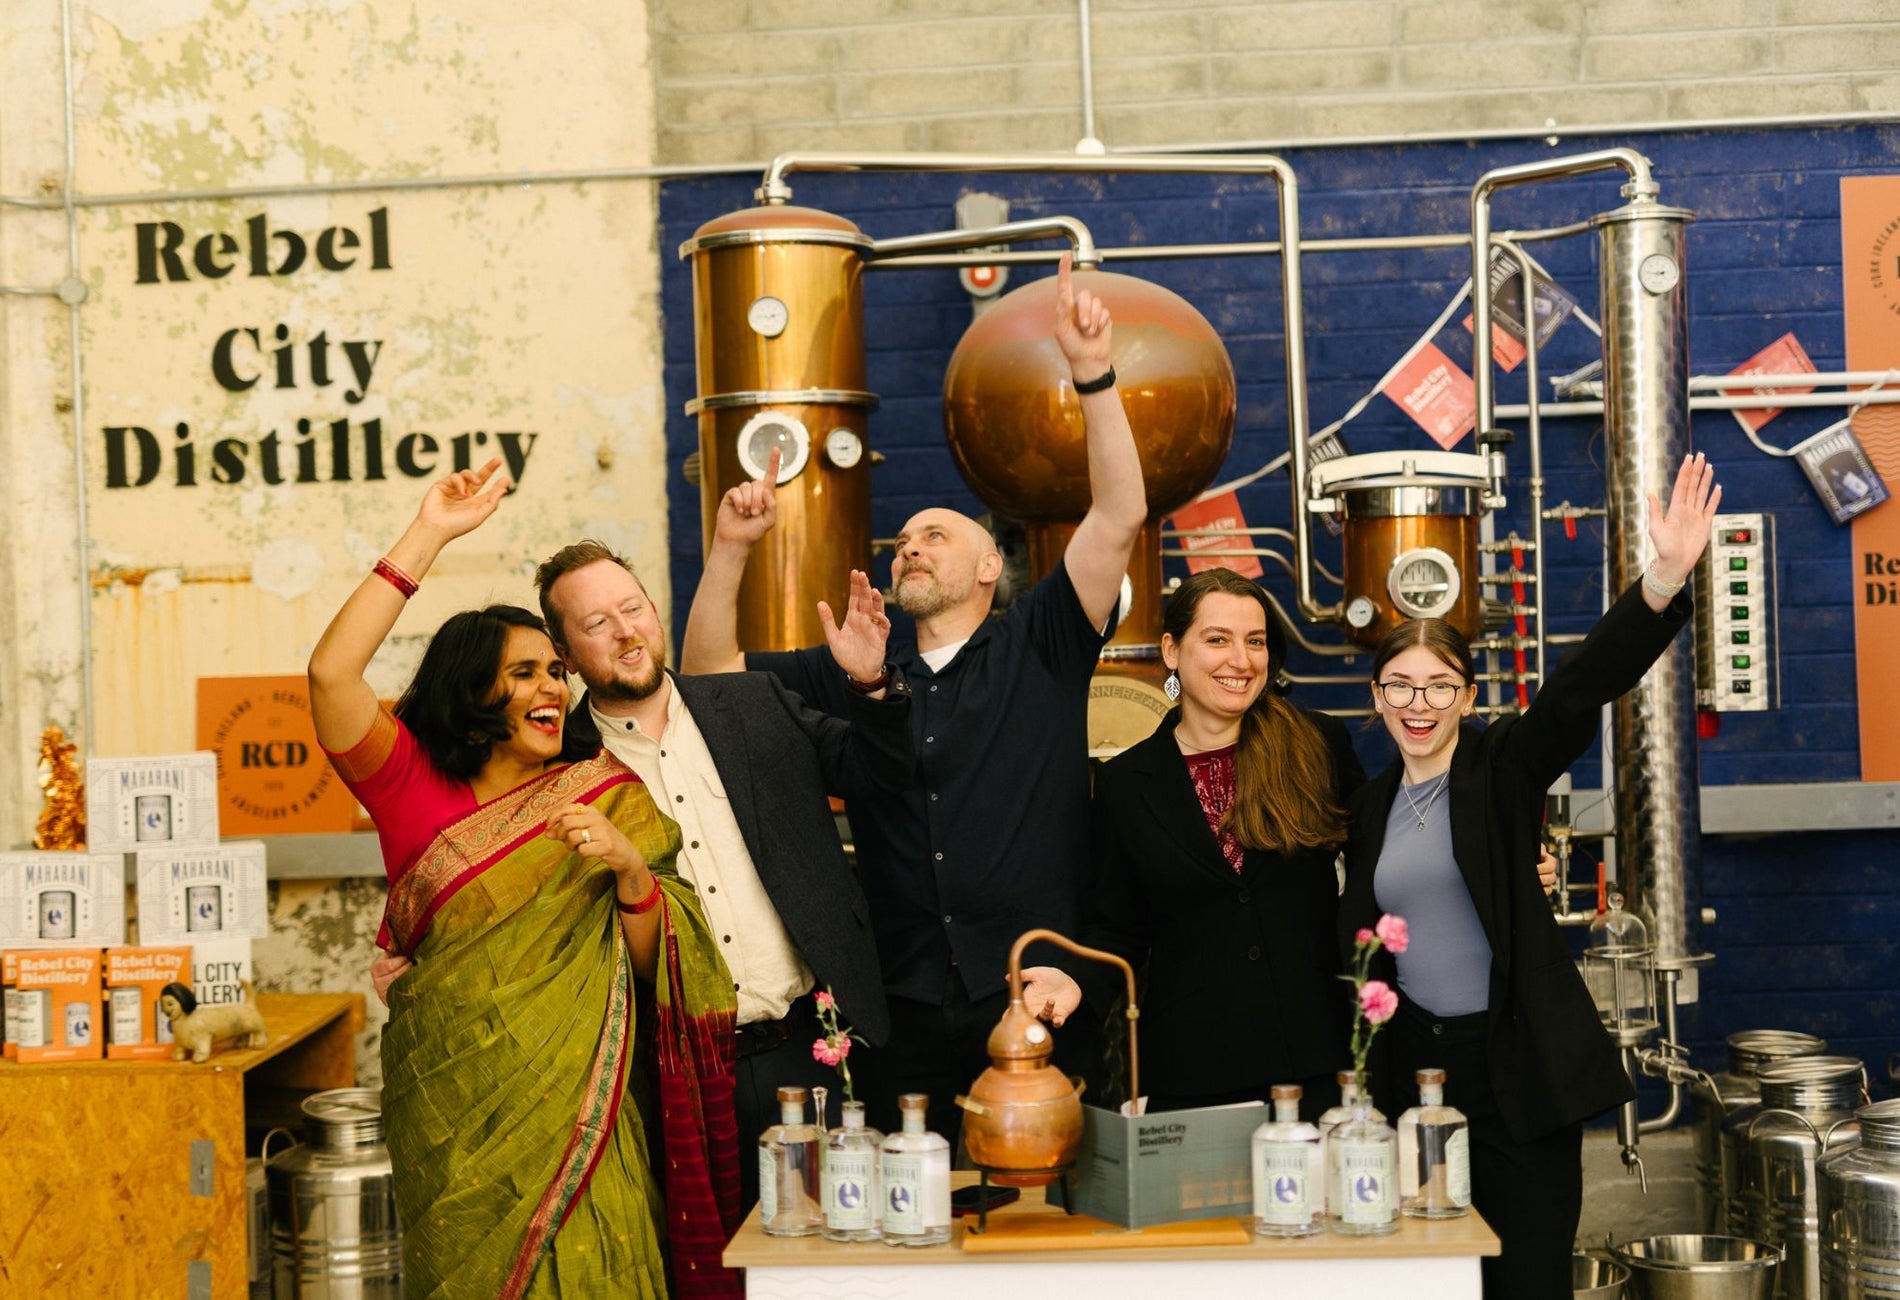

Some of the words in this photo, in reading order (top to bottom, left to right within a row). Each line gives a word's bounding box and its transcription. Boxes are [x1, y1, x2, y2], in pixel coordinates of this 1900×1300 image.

[134, 207, 394, 285] Rebel
[211, 323, 384, 404] City
[101, 417, 539, 495] Distillery
[242, 741, 308, 769] RCD
[121, 769, 184, 795] MAHARANI
[26, 865, 90, 890] MAHARANI
[170, 860, 234, 886] MAHARANI
[21, 958, 62, 971] Rebel
[65, 956, 94, 971] City
[111, 955, 152, 968] Rebel
[155, 953, 183, 969] City
[205, 962, 242, 983] CITY
[21, 971, 88, 985] Distillery
[111, 968, 178, 983] Distillery
[1138, 1125, 1166, 1136] Rebel
[1168, 1123, 1187, 1135] City
[1138, 1135, 1183, 1147] Distillery
